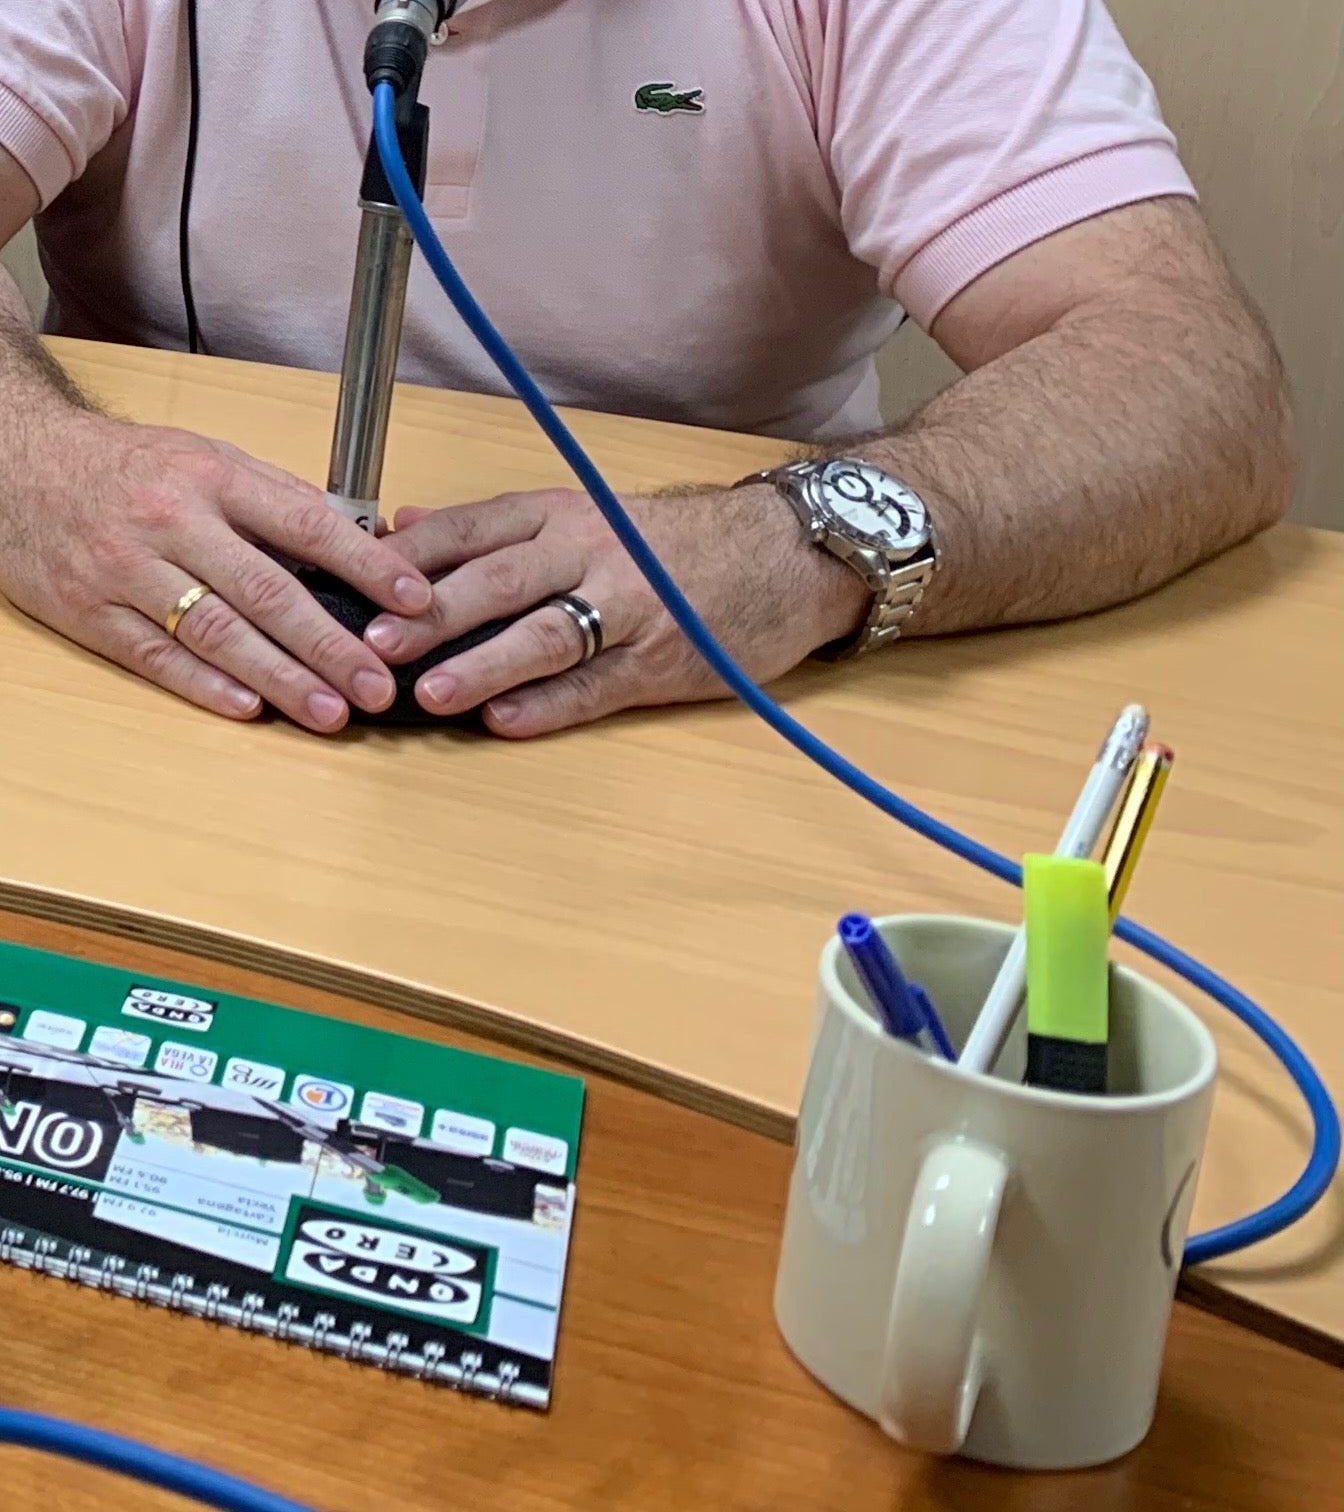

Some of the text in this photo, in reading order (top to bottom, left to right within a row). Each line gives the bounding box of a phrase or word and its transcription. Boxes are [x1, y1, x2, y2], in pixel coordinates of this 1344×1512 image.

[135, 1002, 203, 1024] ONDA
[35, 1176, 59, 1194] FM
[60, 1183, 90, 1200] 97.7
[197, 1195, 275, 1224] Cartagena
[216, 1225, 269, 1246] Murcia
[327, 1225, 449, 1269] CERO
[316, 1251, 456, 1303] ONDA
